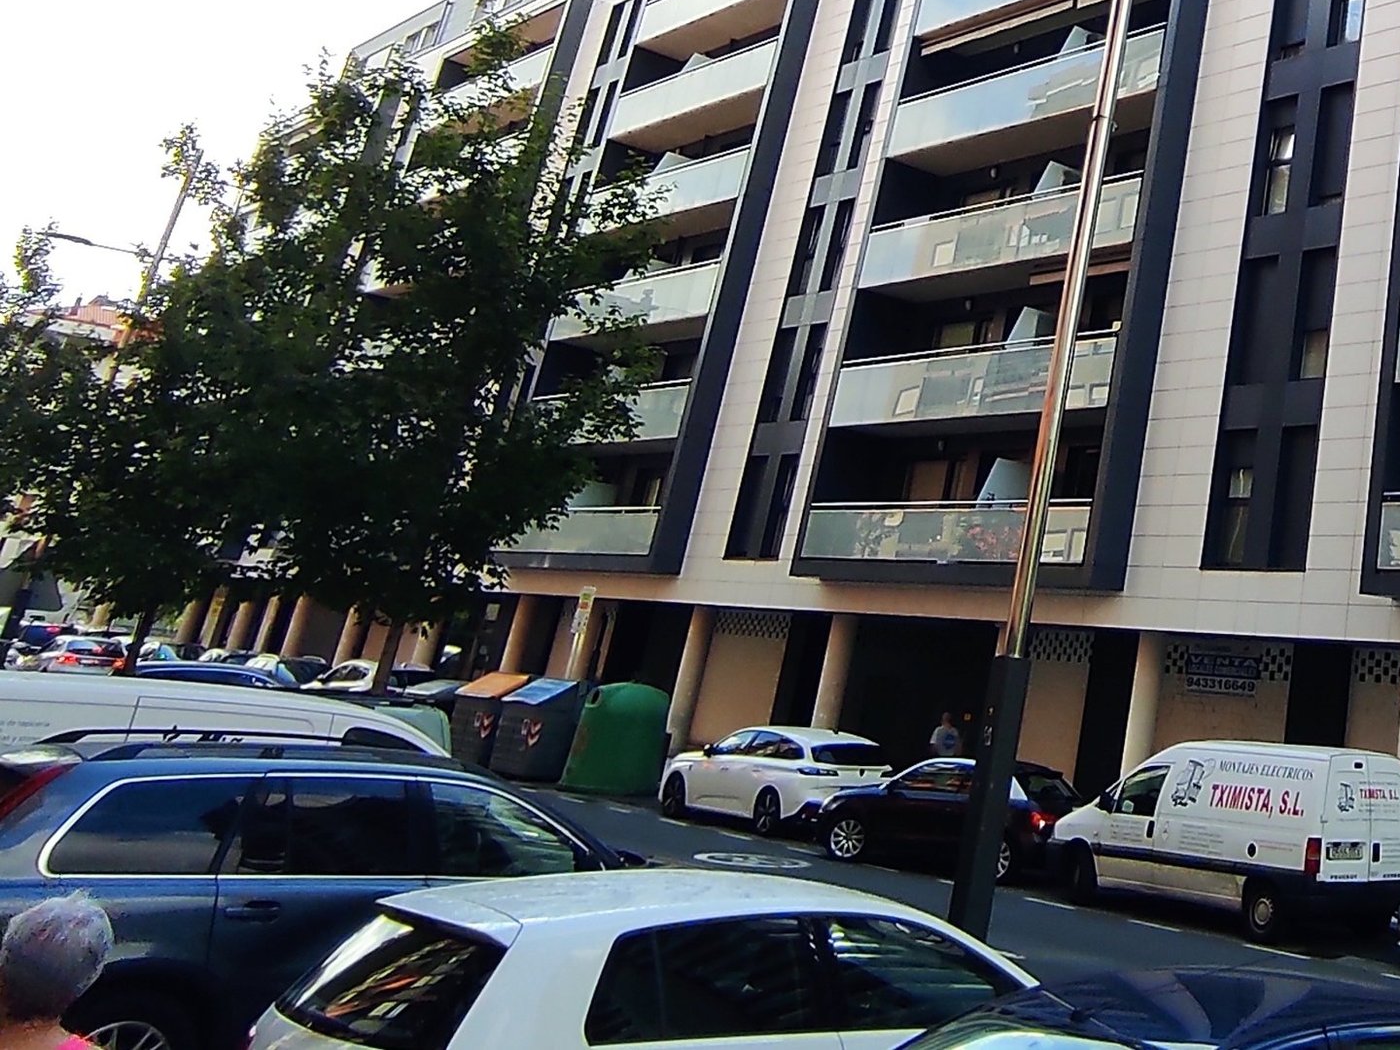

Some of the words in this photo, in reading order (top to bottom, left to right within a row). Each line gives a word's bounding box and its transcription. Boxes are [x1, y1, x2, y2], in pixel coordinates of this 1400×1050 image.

[1190, 655, 1257, 667] VENTA
[1186, 676, 1255, 692] 943316649
[1219, 760, 1259, 775] MONTAJES
[1259, 764, 1314, 781] ELECTRICOS
[1209, 784, 1273, 818] TXIMISTA,
[1279, 790, 1305, 817] S.L.
